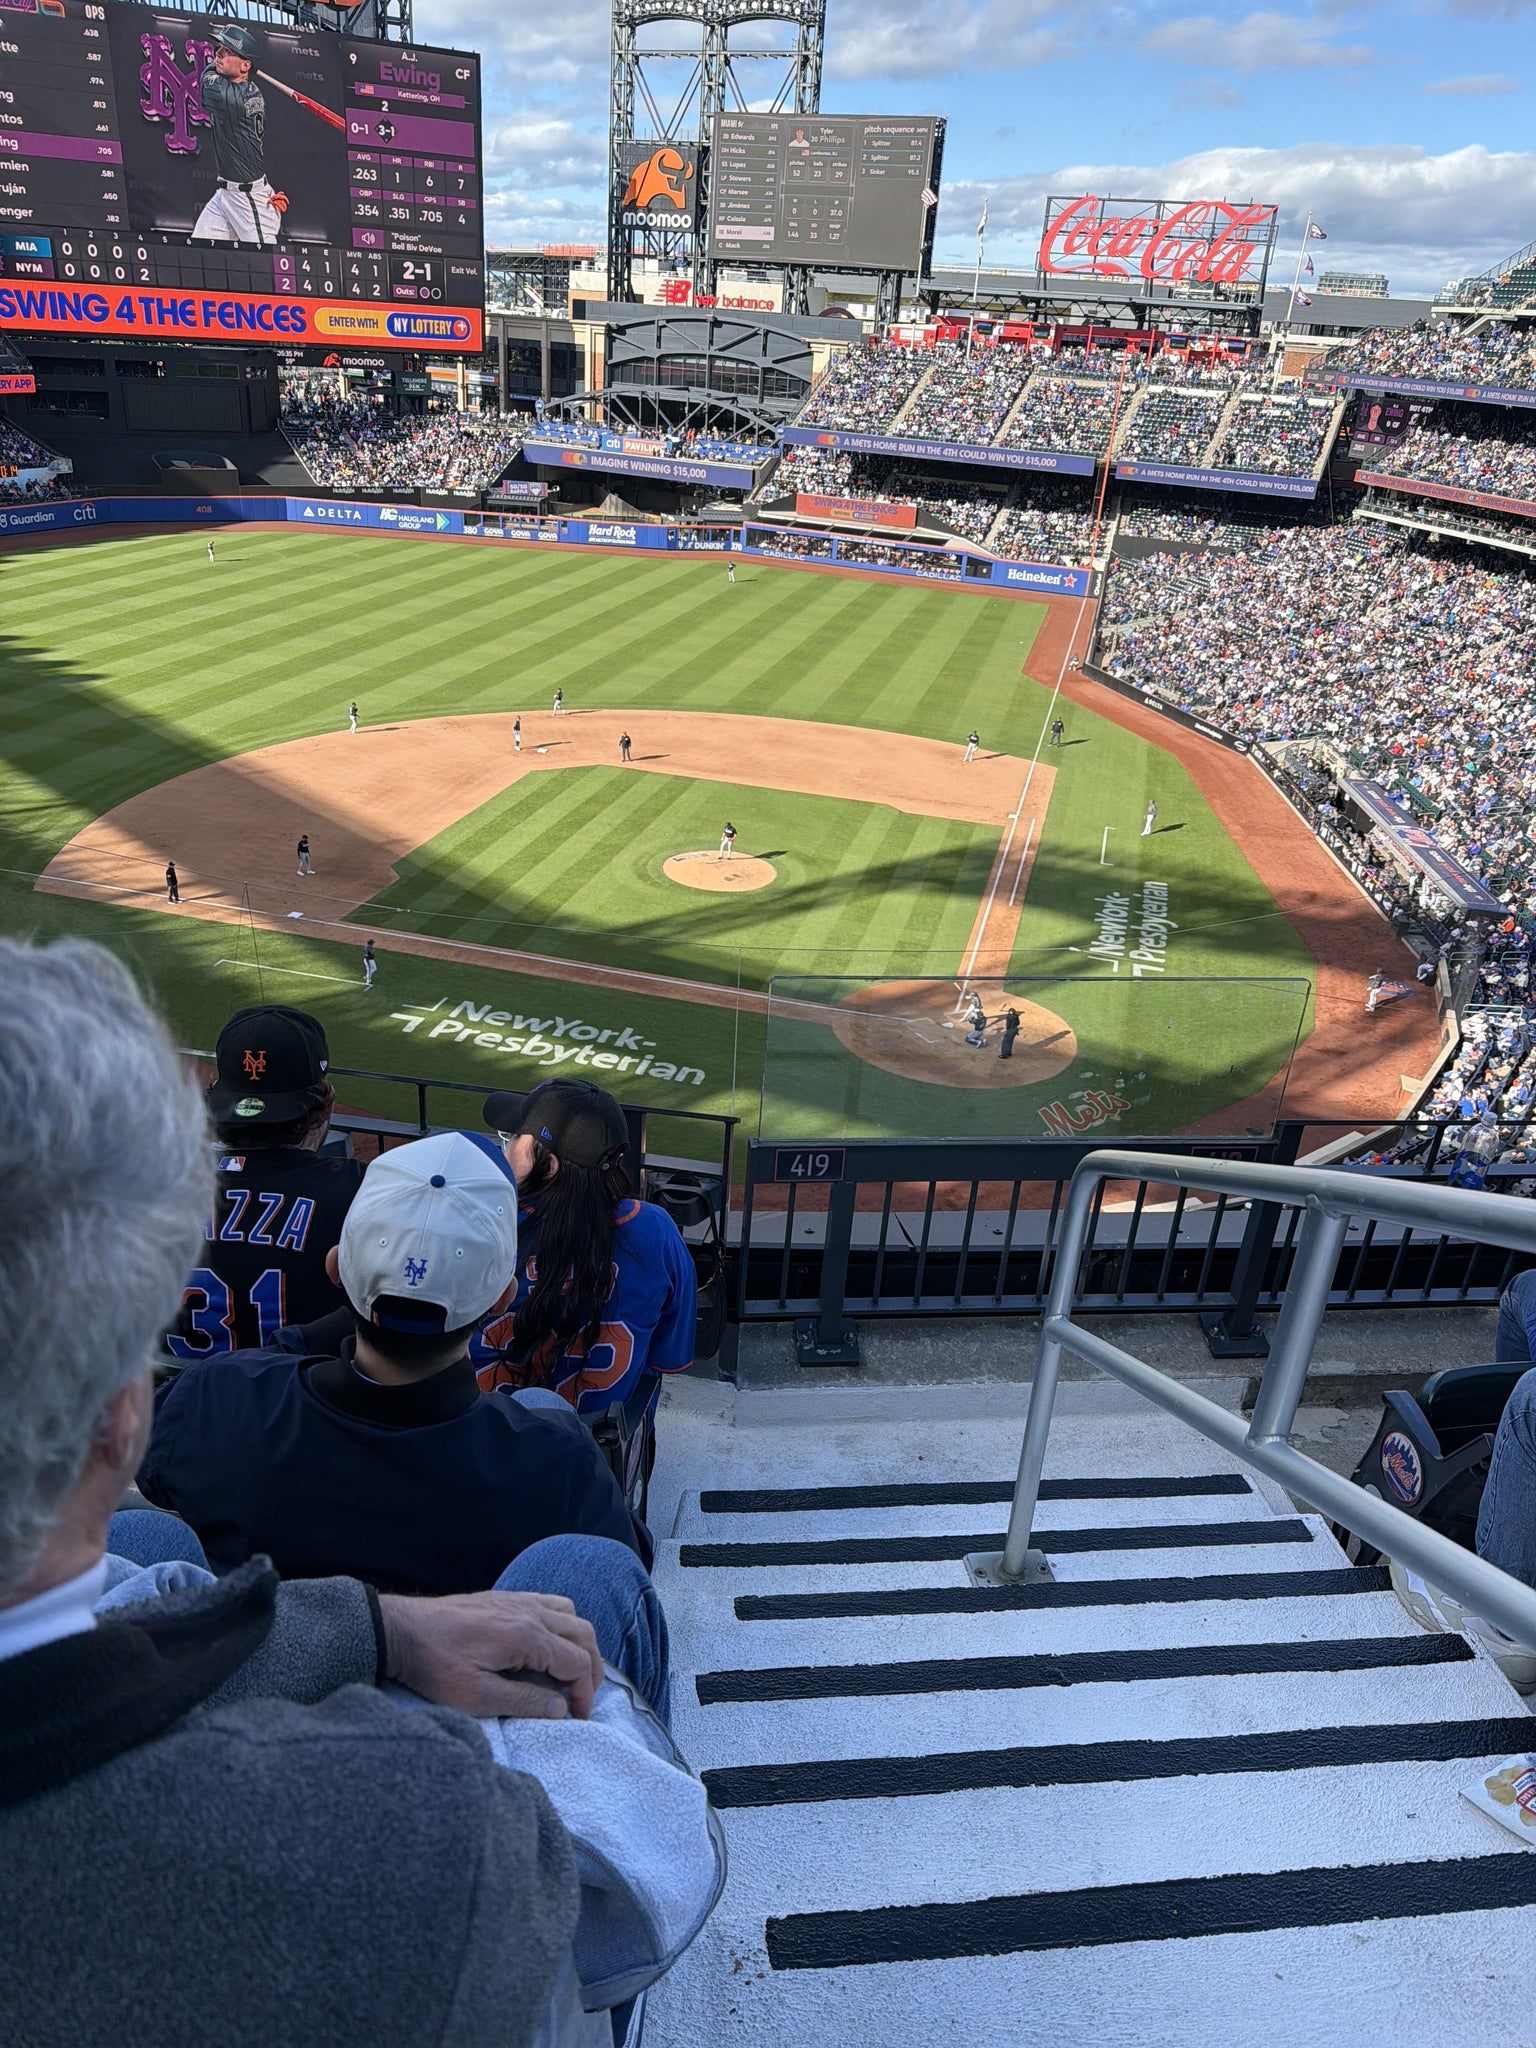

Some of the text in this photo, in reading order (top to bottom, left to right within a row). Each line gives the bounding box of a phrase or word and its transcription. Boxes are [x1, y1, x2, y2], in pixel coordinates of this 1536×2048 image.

[85, 4, 106, 20] OPS
[349, 53, 358, 65] 9
[401, 51, 418, 62] A.J.
[379, 61, 441, 94] Ewing
[455, 68, 471, 80] CF
[397, 90, 429, 102] Kettering,
[381, 101, 389, 112] 2
[351, 122, 395, 137] 0-1 3-1
[864, 125, 915, 135] pitch sequence
[731, 133, 755, 141] Edwards
[820, 136, 846, 145] Phillips
[872, 140, 891, 148] Splitter
[356, 153, 372, 161] AVG
[392, 157, 402, 165] HR
[352, 168, 465, 190] .263 1 6 7
[392, 193, 404, 201] SLG
[424, 196, 437, 204] OPS
[354, 204, 466, 225] .354 .351 .705 4
[622, 211, 692, 229] moomoo
[391, 232, 421, 242] "Poison"
[1039, 195, 1279, 283] Coca-Cola
[391, 242, 443, 254] Bell Biv DeVoe
[15, 241, 378, 277] MIA 0 0 0 0 0 4 1 4 1
[346, 251, 382, 260] MVR ABS
[402, 261, 432, 281] 2-1
[451, 266, 478, 276] Exit Vel.
[15, 262, 381, 296] NYM 0 0 0 2 2 4 0 4 2
[395, 287, 415, 296] Outs:
[694, 294, 775, 311] new balance
[0, 287, 307, 334] SWING 4 THE FENCES
[328, 316, 379, 329] ENTER WITH
[393, 317, 452, 336] NY LOTTERY
[343, 358, 385, 367] moomoo
[15, 379, 31, 389] APP
[606, 436, 620, 448] citi
[843, 438, 1057, 468] A METS HOME RUN IN THE 4TH COULD WIN YOU $15,000
[591, 456, 706, 479] IMAGINE WINNING $15,000
[1147, 470, 1165, 478] METS
[1165, 471, 1186, 480] HOME
[1186, 473, 1200, 481] RUN
[1201, 474, 1209, 482] IN
[1222, 477, 1235, 485] 4TH
[1235, 479, 1258, 487] COULD
[1274, 482, 1288, 490] YOU
[1289, 484, 1315, 493] $15,000
[74, 506, 96, 520] citi
[814, 497, 841, 508] SWING
[851, 502, 867, 511] THE
[867, 504, 899, 515] FENCES
[10, 512, 55, 525] Guardian
[318, 507, 361, 520] DELTA
[399, 515, 435, 523] HAUGLAND
[463, 526, 478, 535] 380
[589, 524, 636, 539] Hard Rock
[695, 541, 725, 550] DUNKIN'
[731, 542, 742, 551] 370
[763, 550, 805, 560] CADILLAC
[916, 571, 961, 581] CADILLAC
[1008, 568, 1060, 585] Heineken
[1129, 881, 1179, 963] Presbyterian
[448, 1000, 657, 1051] NewYork-
[427, 1019, 706, 1086] Presbyterian
[243, 1050, 267, 1081] NY
[1038, 1090, 1131, 1137] Mets
[790, 1154, 830, 1176] 419
[404, 1257, 429, 1287] NY
[167, 1266, 287, 1359] 31
[1388, 1453, 1414, 1491] Mets
